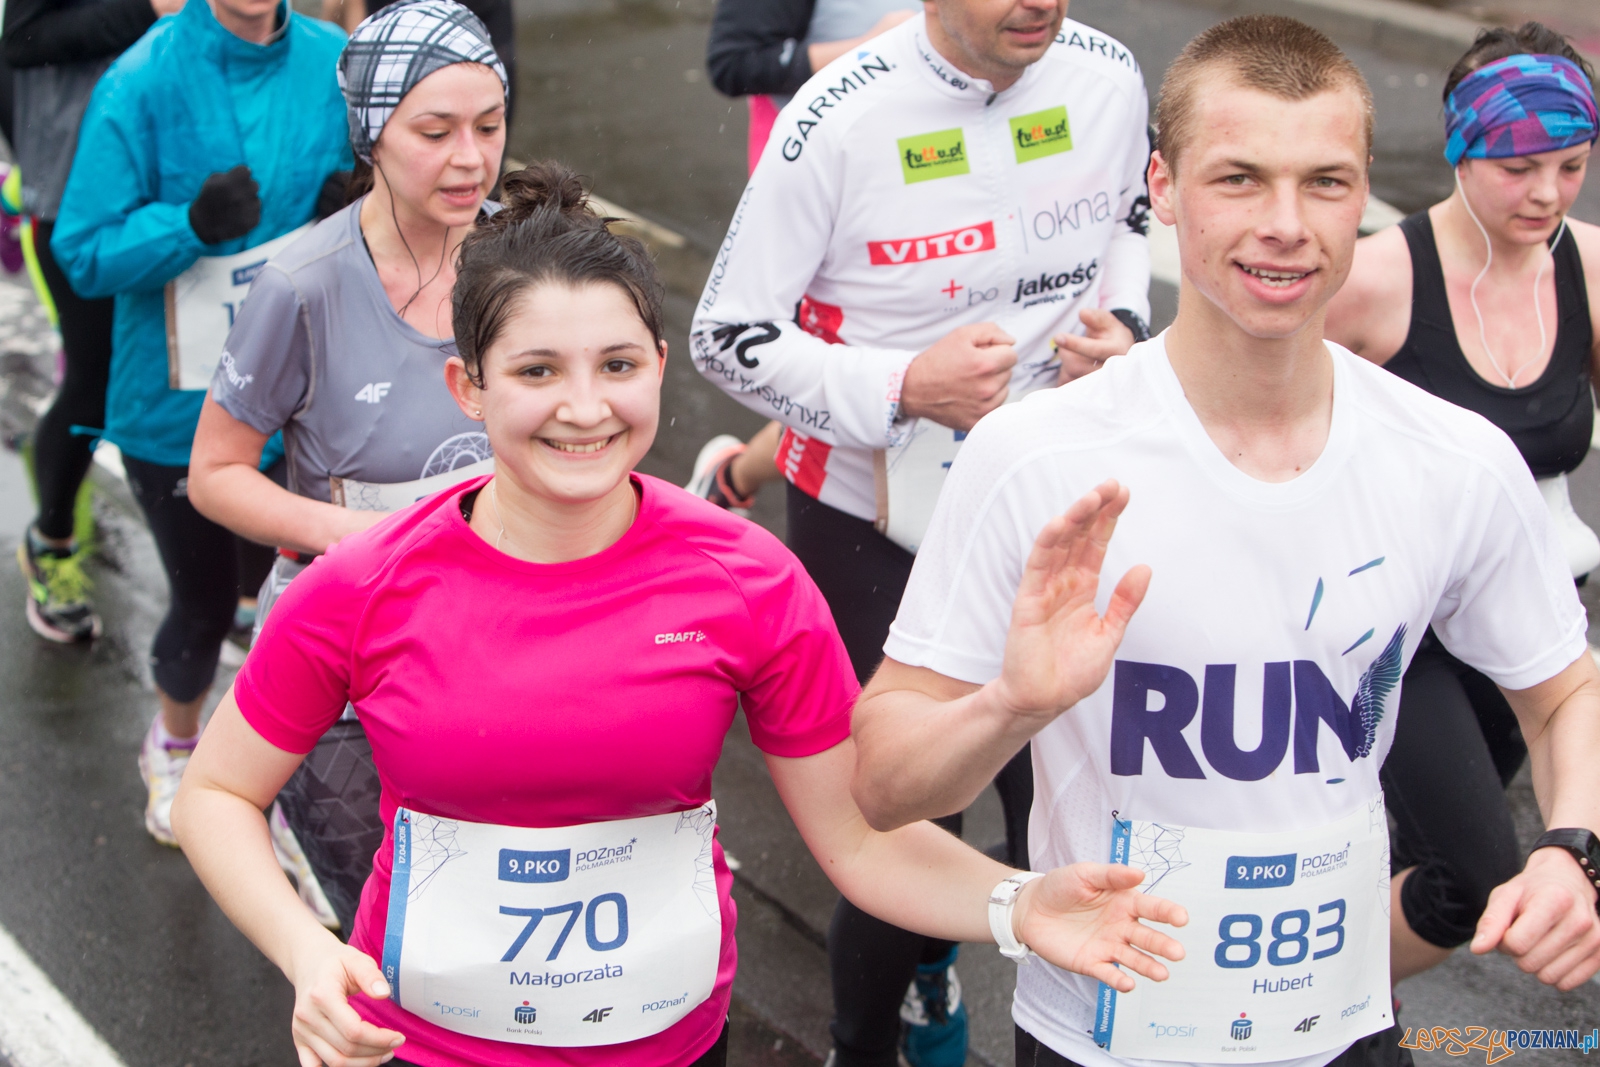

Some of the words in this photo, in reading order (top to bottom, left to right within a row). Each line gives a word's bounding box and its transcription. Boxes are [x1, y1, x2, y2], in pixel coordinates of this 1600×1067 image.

[782, 55, 893, 162] GARMIN
[1033, 191, 1111, 241] okna
[881, 228, 984, 263] VITO
[1013, 258, 1097, 303] jakość
[354, 382, 392, 404] 4F
[654, 631, 697, 644] CRAFT
[1110, 658, 1382, 782] RUN
[525, 859, 561, 874] PKO
[575, 855, 632, 873] PÓŁMARATON
[1252, 863, 1287, 880] PKO
[1300, 860, 1348, 878] PÓŁMARATON
[499, 892, 629, 963] 770
[1214, 898, 1346, 969] 883
[509, 963, 623, 989] Małgorzata
[1252, 973, 1314, 994] Hubert
[582, 1006, 614, 1023] 4F
[1294, 1014, 1321, 1033] 4F
